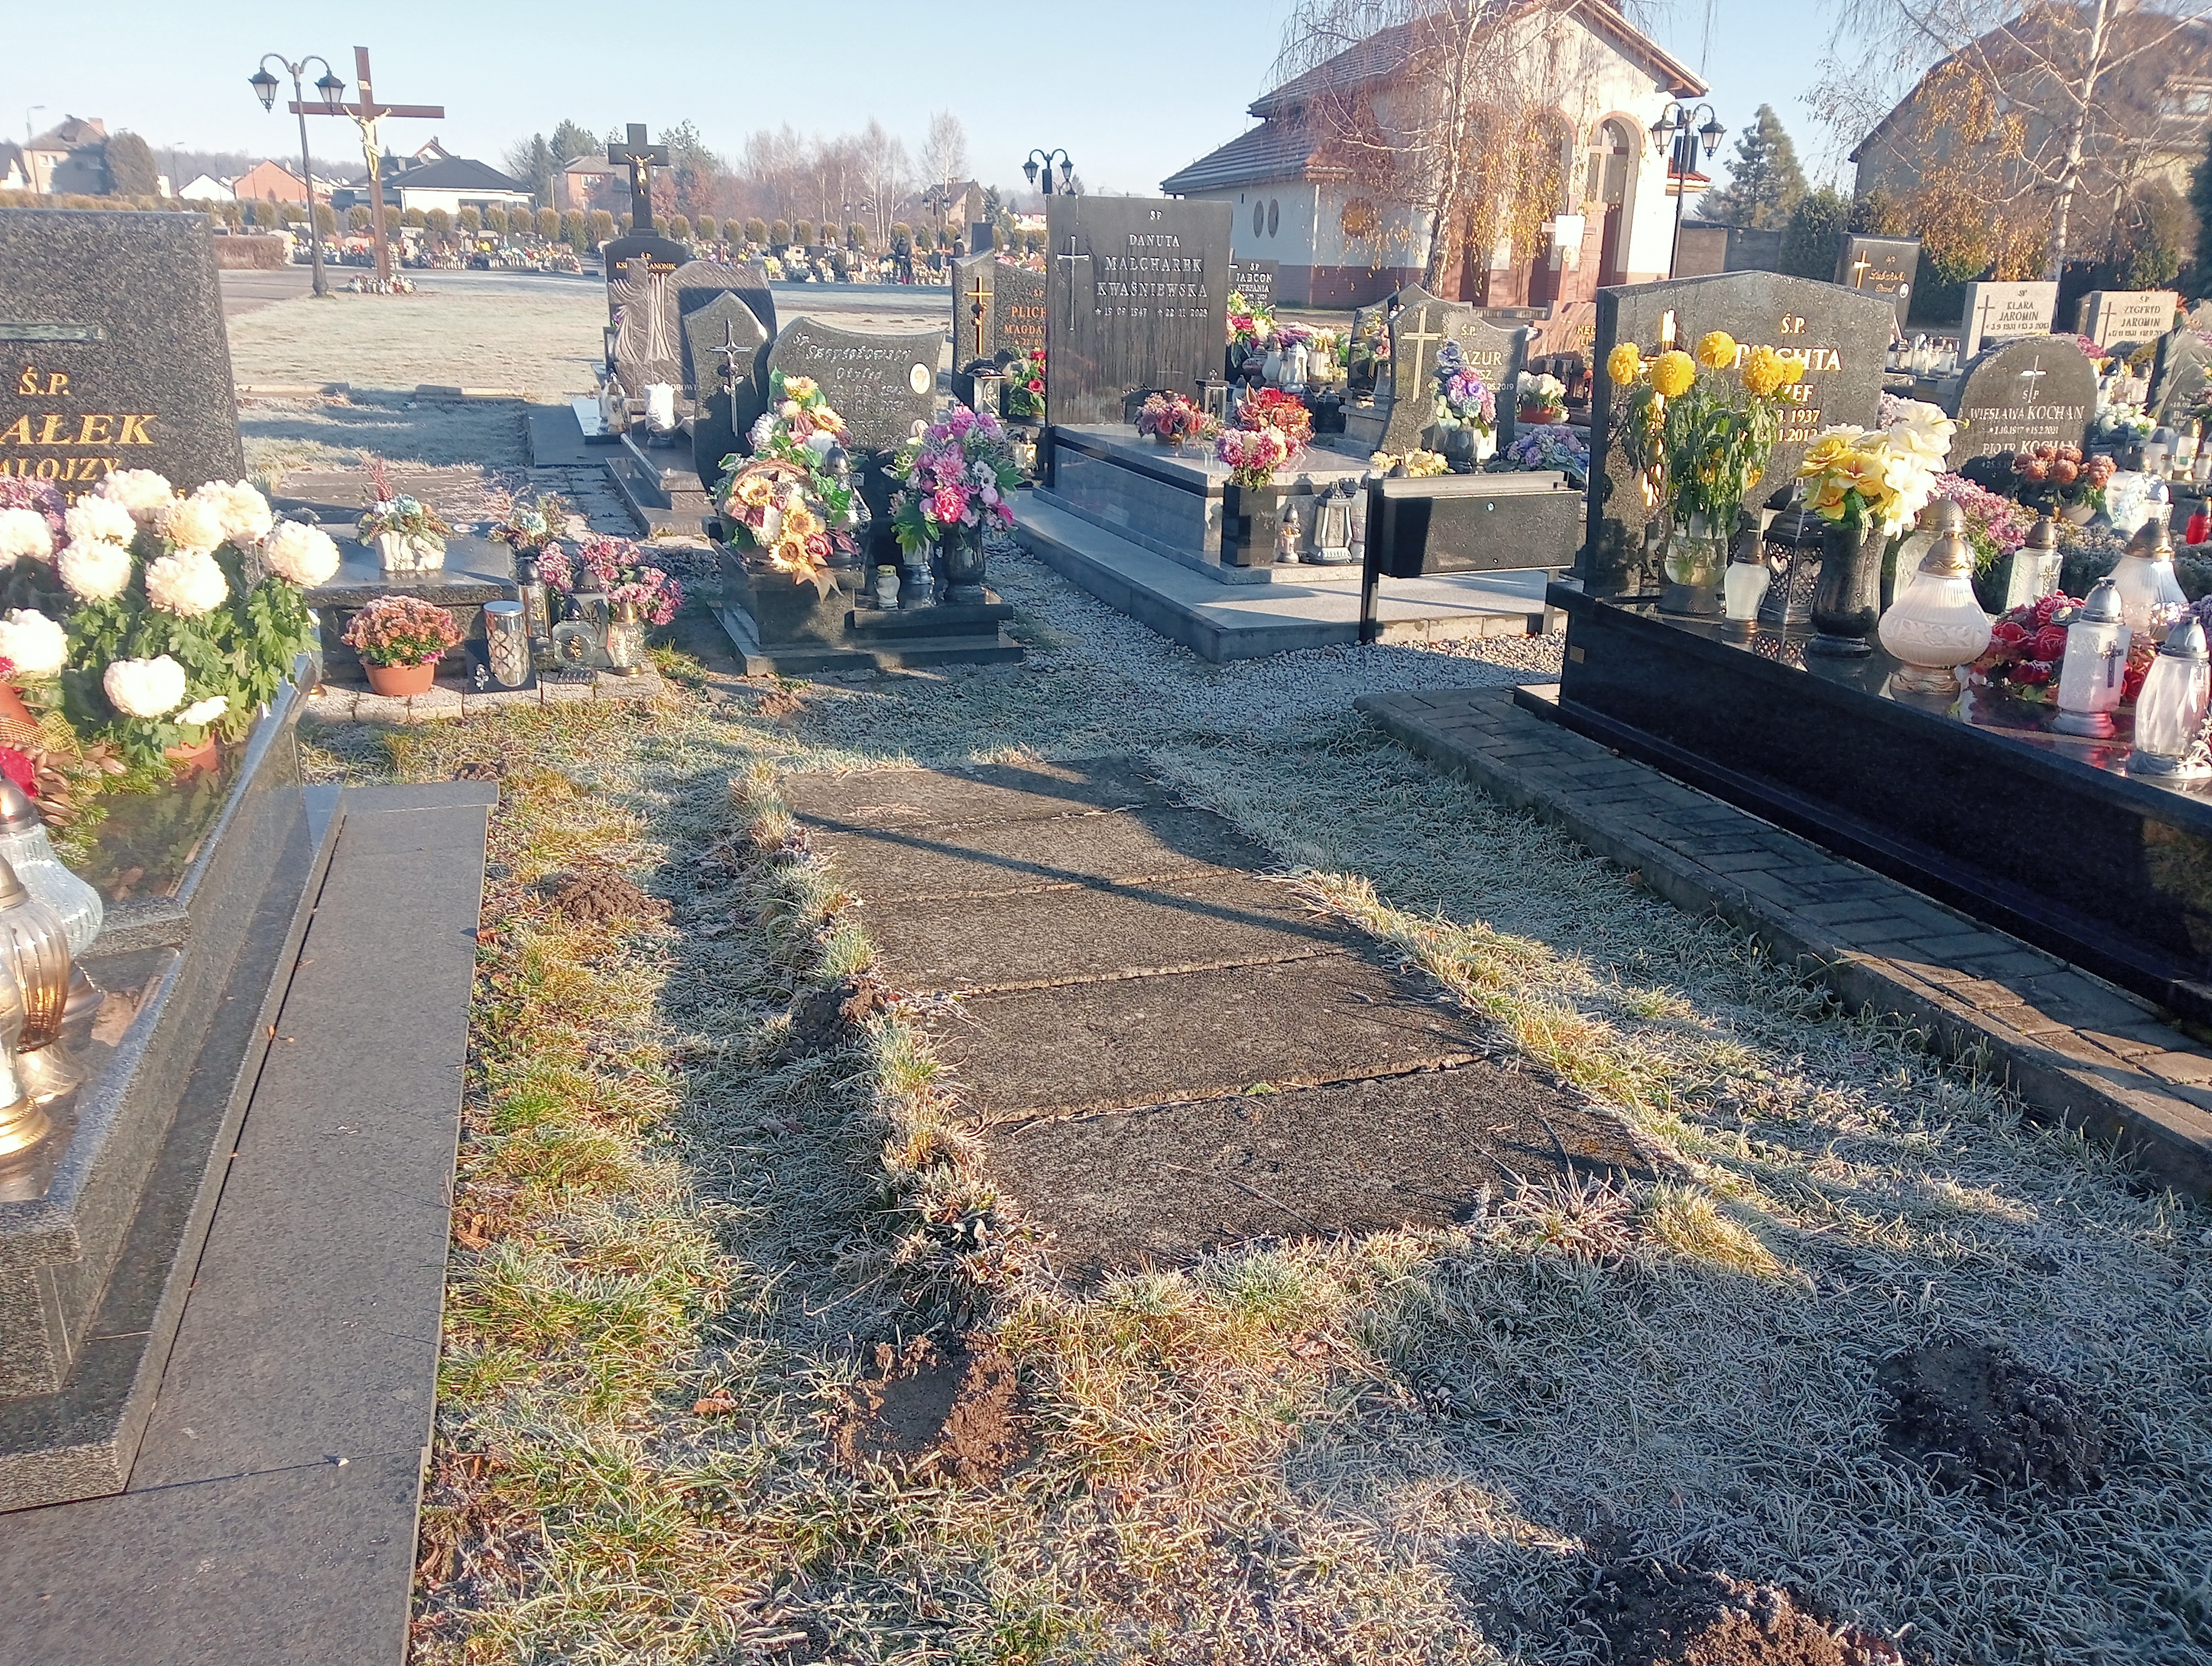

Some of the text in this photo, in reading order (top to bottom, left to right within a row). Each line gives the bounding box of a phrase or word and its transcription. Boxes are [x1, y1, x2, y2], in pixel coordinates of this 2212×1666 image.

[1129, 234, 1180, 247] DANUTA
[1105, 256, 1203, 272] MALCHAREK
[1097, 281, 1208, 298] KWAŚNIEWSKA
[1011, 306, 1046, 318] PLICH
[2007, 302, 2034, 310] KLARA
[1781, 312, 1806, 334] Ś.P.
[1999, 311, 2039, 321] JAROMIN
[2121, 318, 2160, 326] JAROMIN
[1461, 351, 1503, 365] AZUR
[18, 366, 70, 395] Ś.P.
[1791, 409, 1821, 424] 1937
[2027, 406, 2086, 420] KOCHAN
[0, 414, 158, 445] AŁEK
